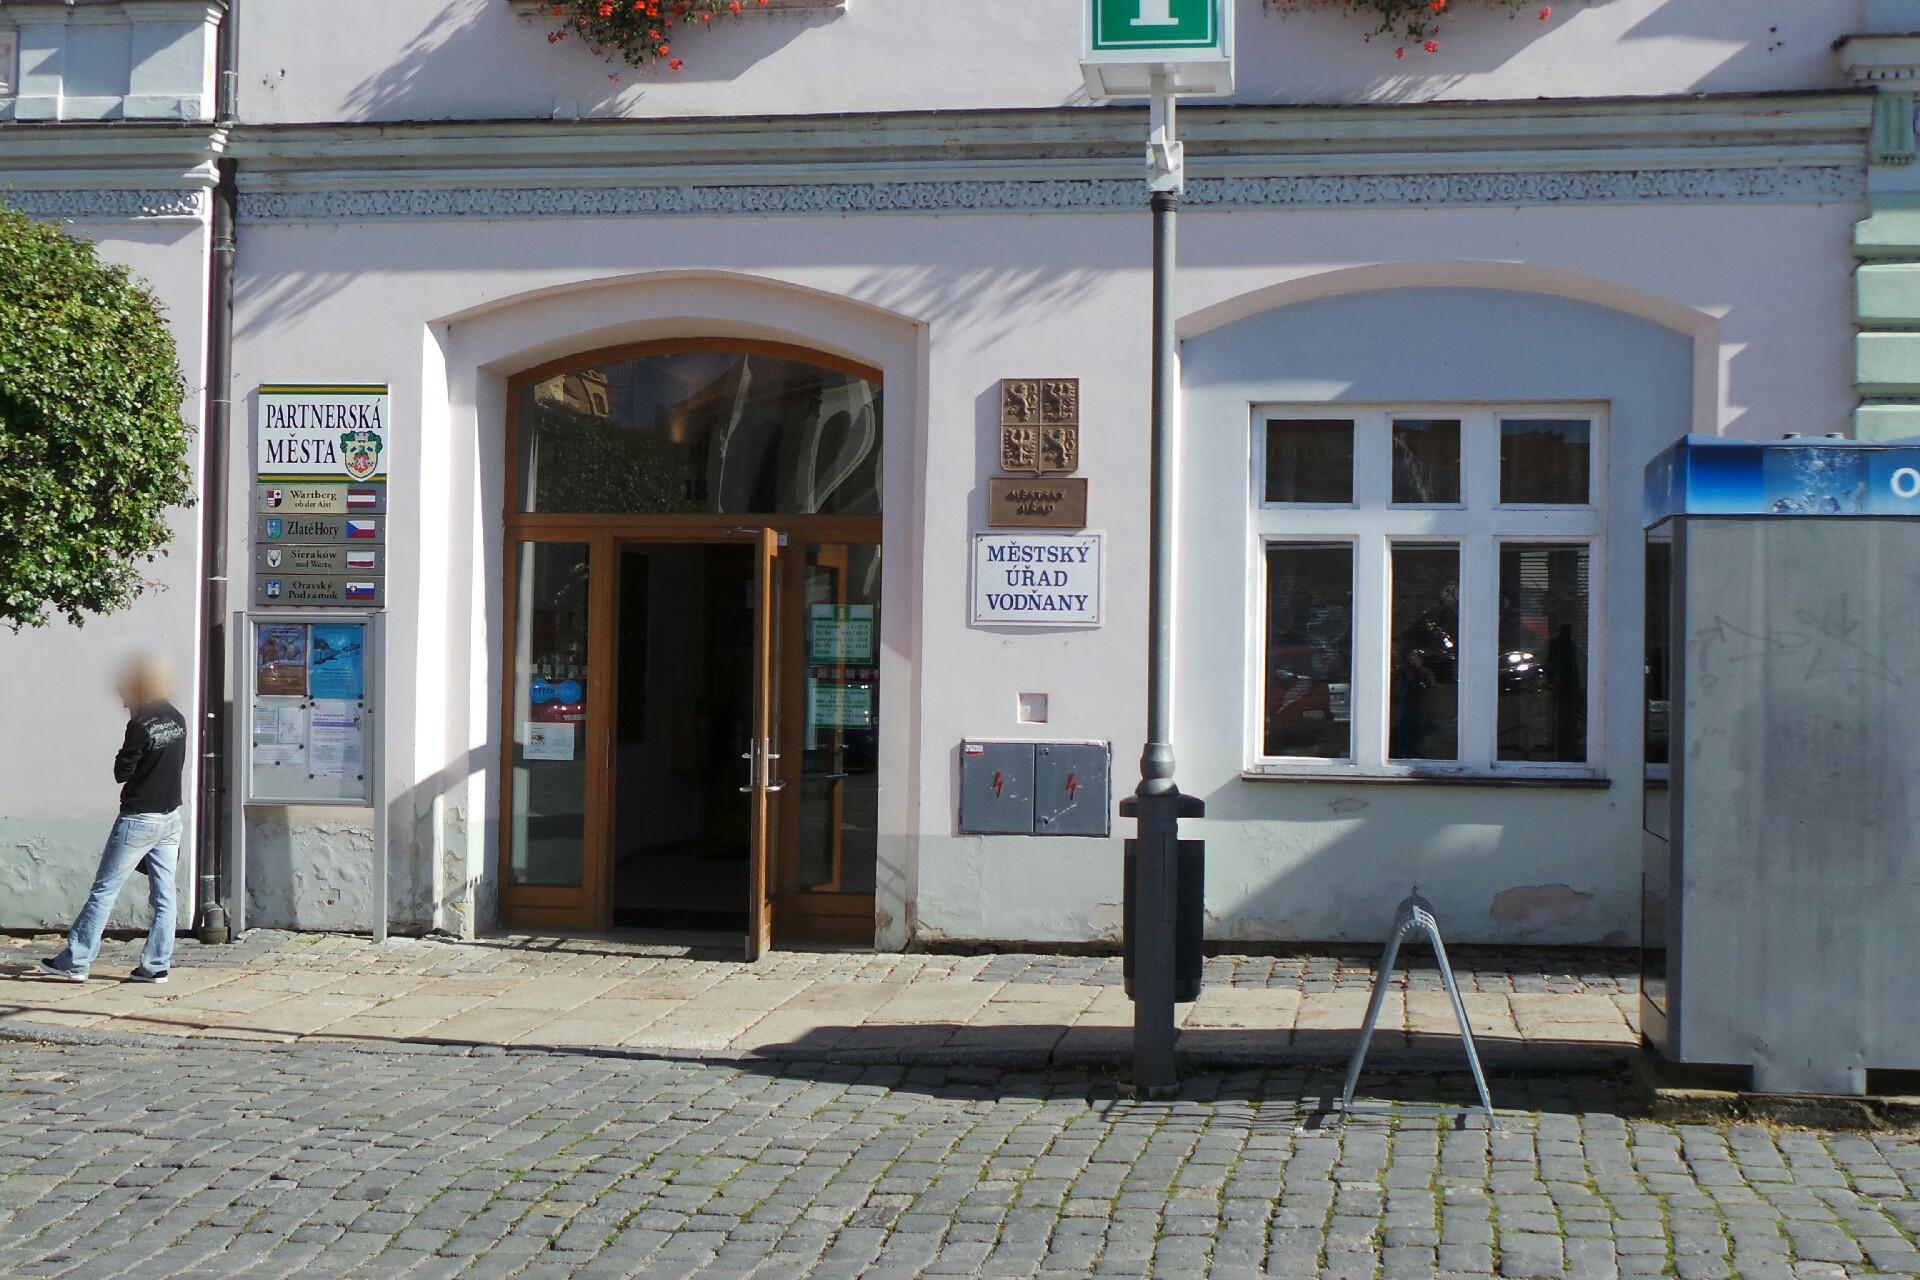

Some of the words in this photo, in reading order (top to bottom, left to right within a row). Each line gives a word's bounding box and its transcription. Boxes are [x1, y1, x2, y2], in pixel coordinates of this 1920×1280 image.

[265, 398, 382, 429] PARTNERSKÁ
[265, 432, 337, 464] MĚSTA
[291, 490, 337, 501] Wartberg
[287, 521, 314, 535] Zlaté
[315, 521, 340, 539] Hory
[987, 541, 1090, 563] MĚSTSKÝ
[292, 580, 333, 591] Oravský
[1006, 565, 1068, 587] ÚŘAD
[986, 589, 1089, 611] VODŇANY
